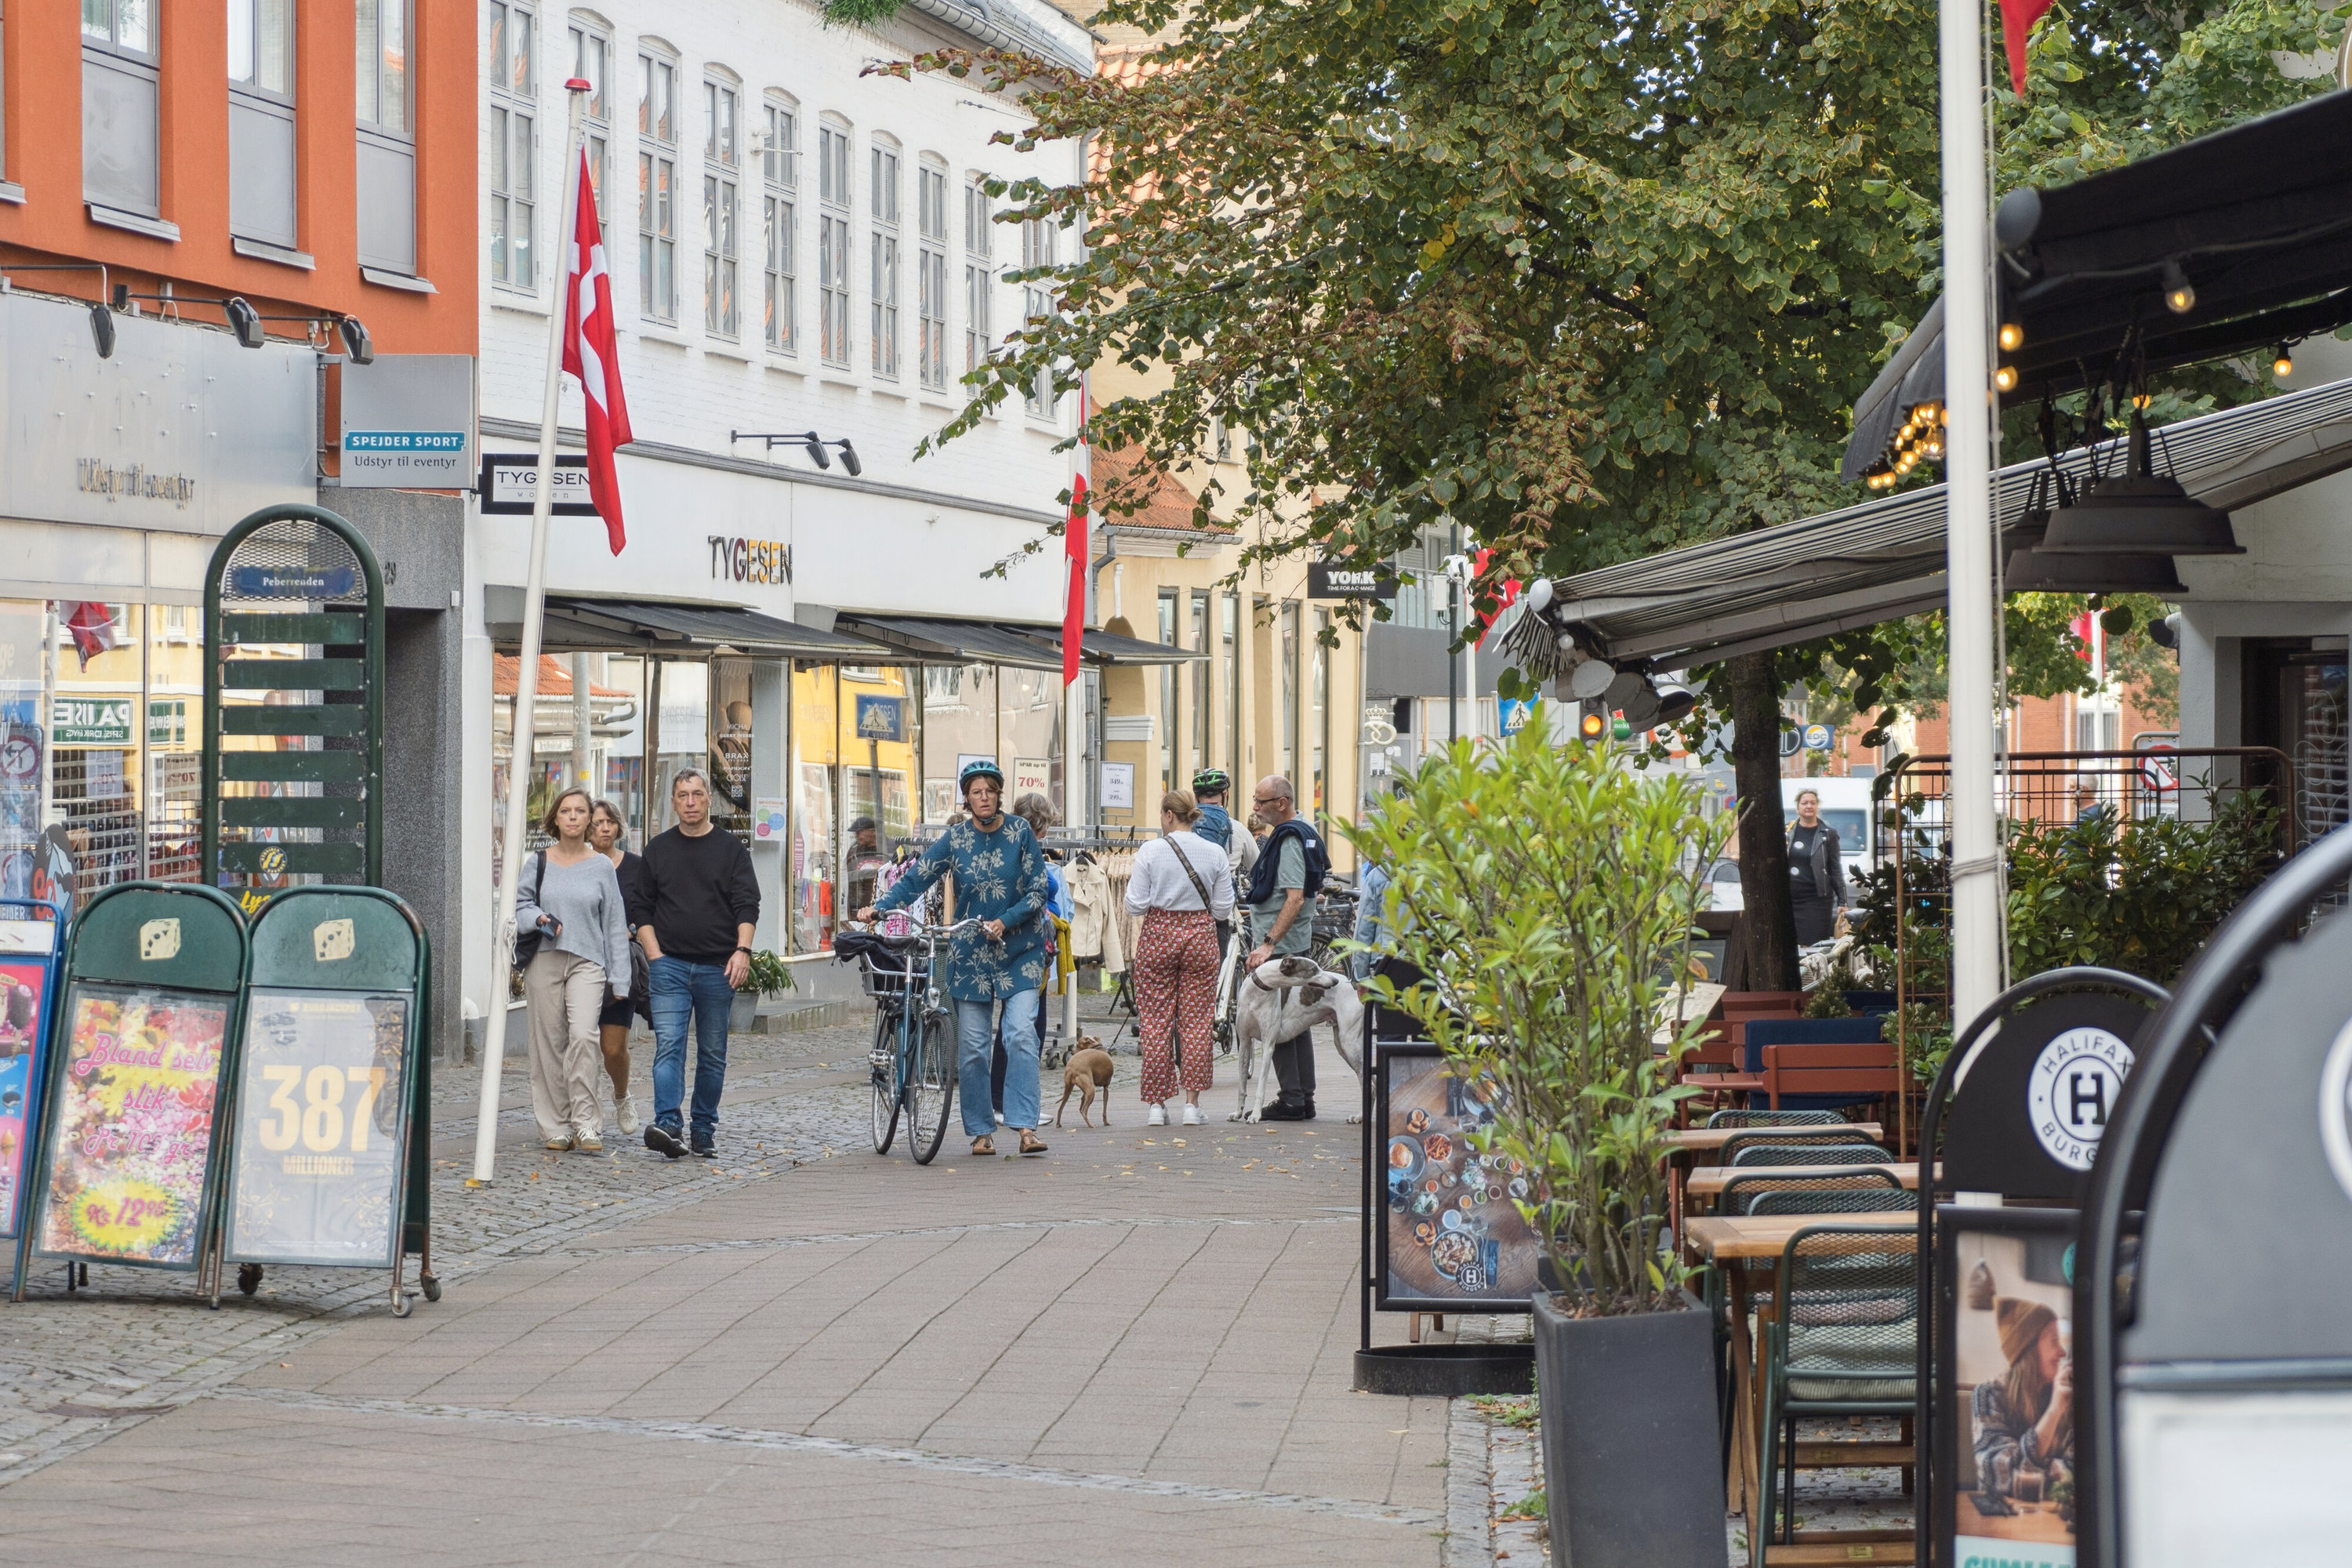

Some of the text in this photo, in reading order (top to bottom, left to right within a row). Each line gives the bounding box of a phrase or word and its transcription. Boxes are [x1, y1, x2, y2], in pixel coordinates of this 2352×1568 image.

[353, 436, 459, 447] SPEJDER SPORT
[354, 456, 457, 470] Udstyr til eventyr
[496, 471, 590, 485] TYGSEN
[708, 535, 793, 586] TYGESEN
[263, 576, 325, 586] Peberrenden
[1018, 777, 1045, 788] 70%
[75, 1033, 217, 1075] Bland selv
[2042, 1034, 2133, 1075] HALIFAX
[122, 1080, 168, 1112] slik
[259, 1064, 387, 1152] 387
[83, 1126, 118, 1155] Pr
[162, 1141, 192, 1166] gr
[281, 1155, 354, 1175] MILLIONER
